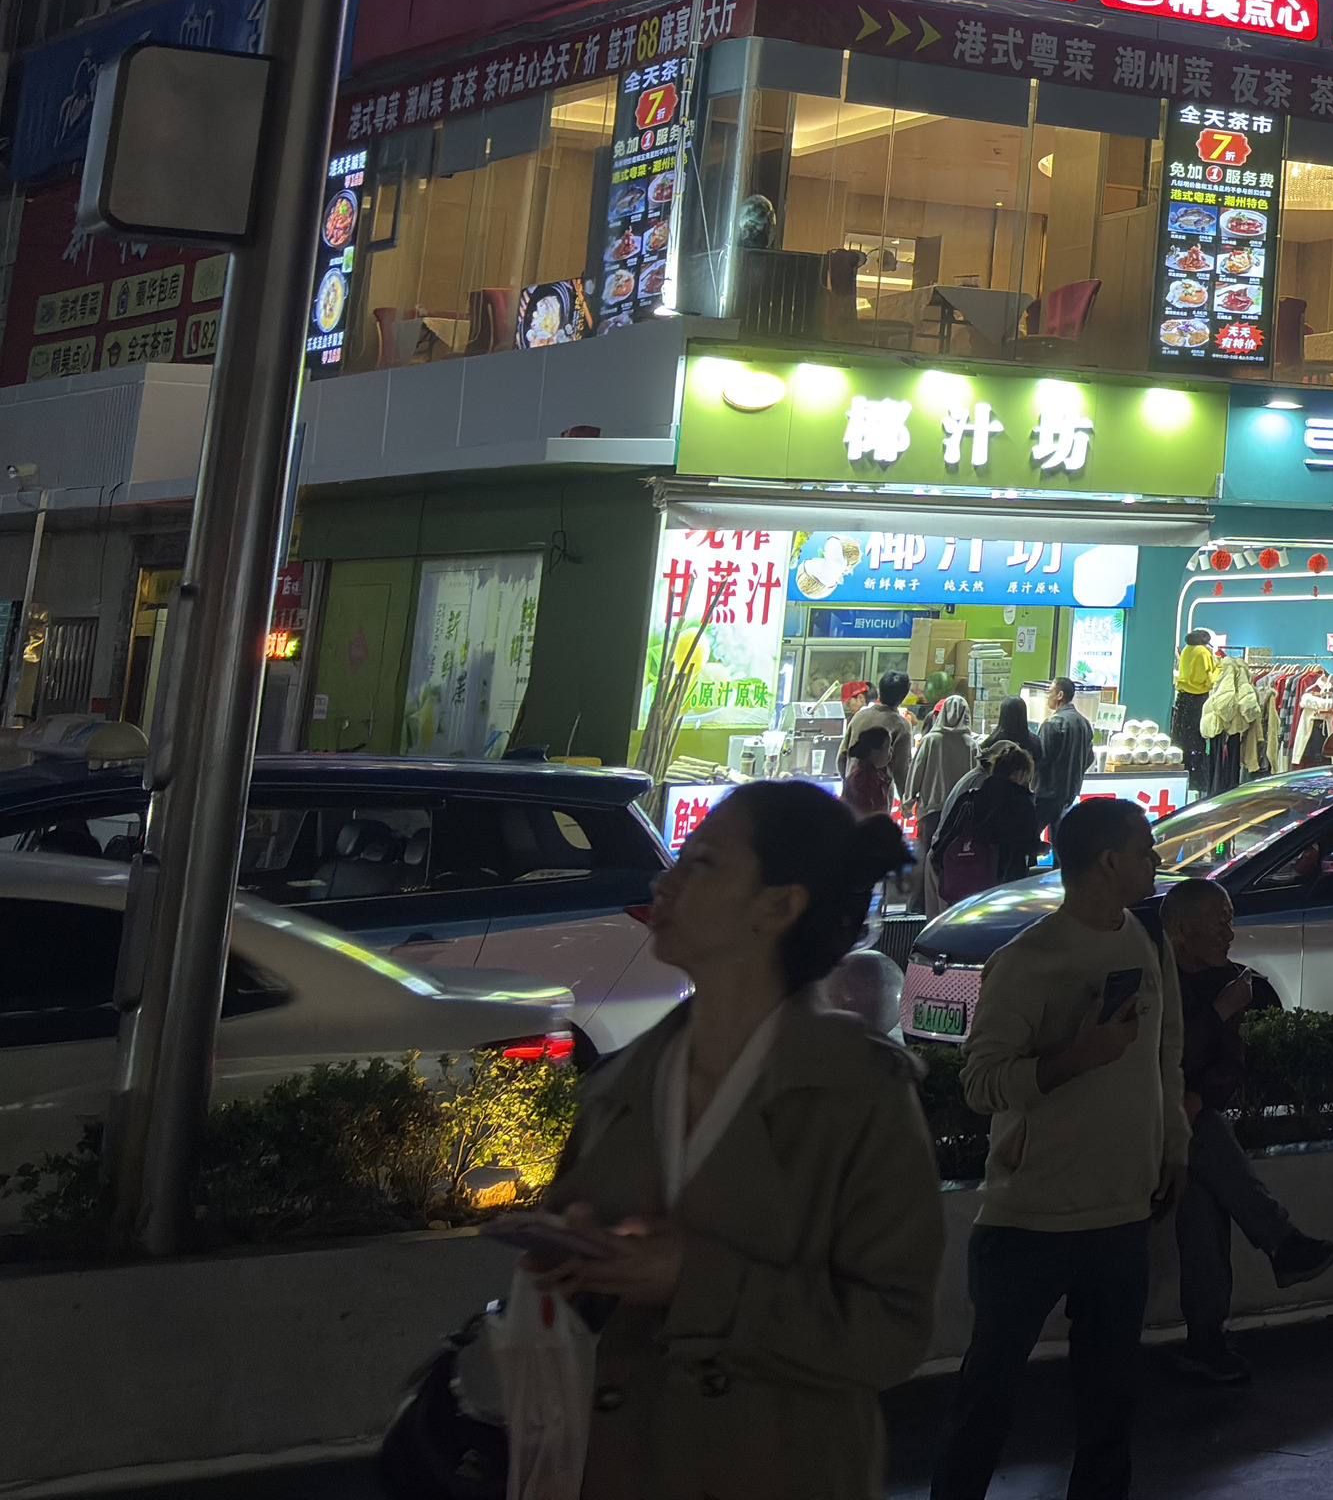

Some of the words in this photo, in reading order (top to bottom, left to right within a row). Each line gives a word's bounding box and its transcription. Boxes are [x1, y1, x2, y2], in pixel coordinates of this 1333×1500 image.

[953, 19, 1097, 82] 港式粤菜
[1113, 46, 1213, 98] 潮州菜
[1231, 64, 1292, 110] 夜茶
[1179, 105, 1273, 134] 全天茶市
[1209, 133, 1236, 162] 7折
[843, 395, 1094, 472] 椰汁坊
[662, 557, 781, 626] 甘蔗汁
[863, 577, 920, 591] 新鲜椰子
[943, 580, 985, 593] 纯天然
[1006, 581, 1061, 595] 原汁原味
